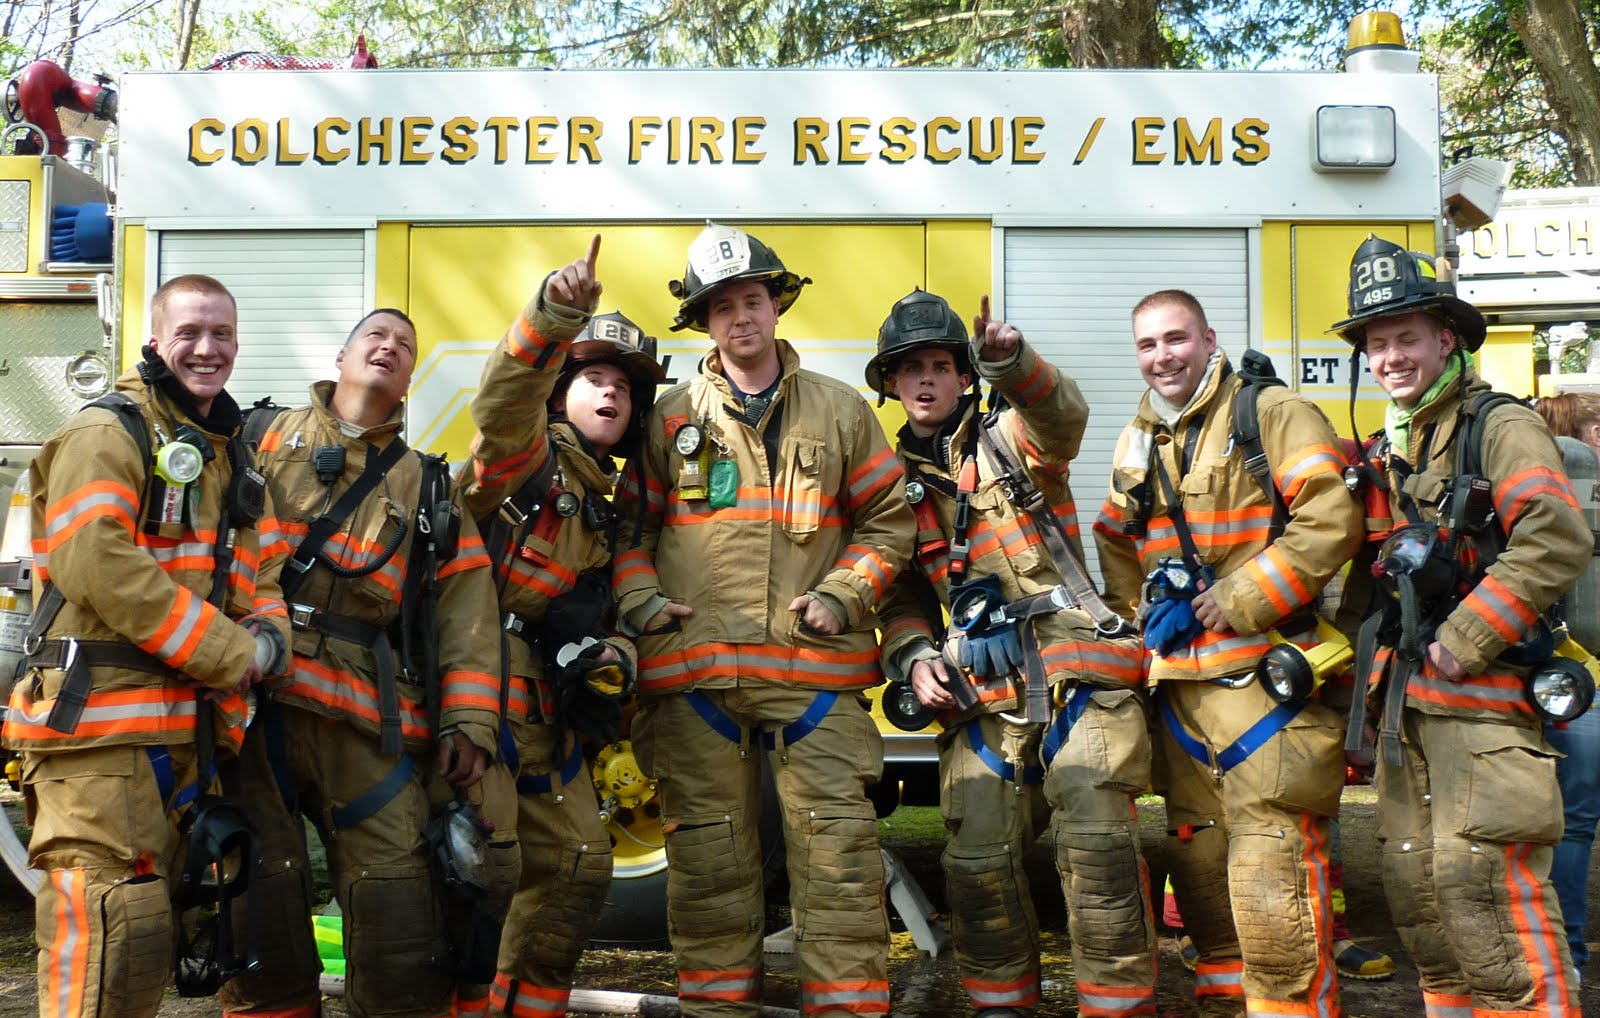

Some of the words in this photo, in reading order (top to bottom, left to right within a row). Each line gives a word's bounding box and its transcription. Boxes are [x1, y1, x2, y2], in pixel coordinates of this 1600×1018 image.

[188, 116, 602, 166] COLCHESTER
[628, 116, 767, 165] FIRE
[794, 116, 1046, 166] RESCUE
[1073, 117, 1105, 165] /
[1132, 116, 1270, 166] EMS
[1459, 220, 1594, 259] OLCH
[711, 265, 741, 280] PTAIN
[1357, 256, 1396, 290] 28
[1363, 287, 1393, 305] 495
[605, 324, 630, 343] 28
[1301, 358, 1339, 383] ET
